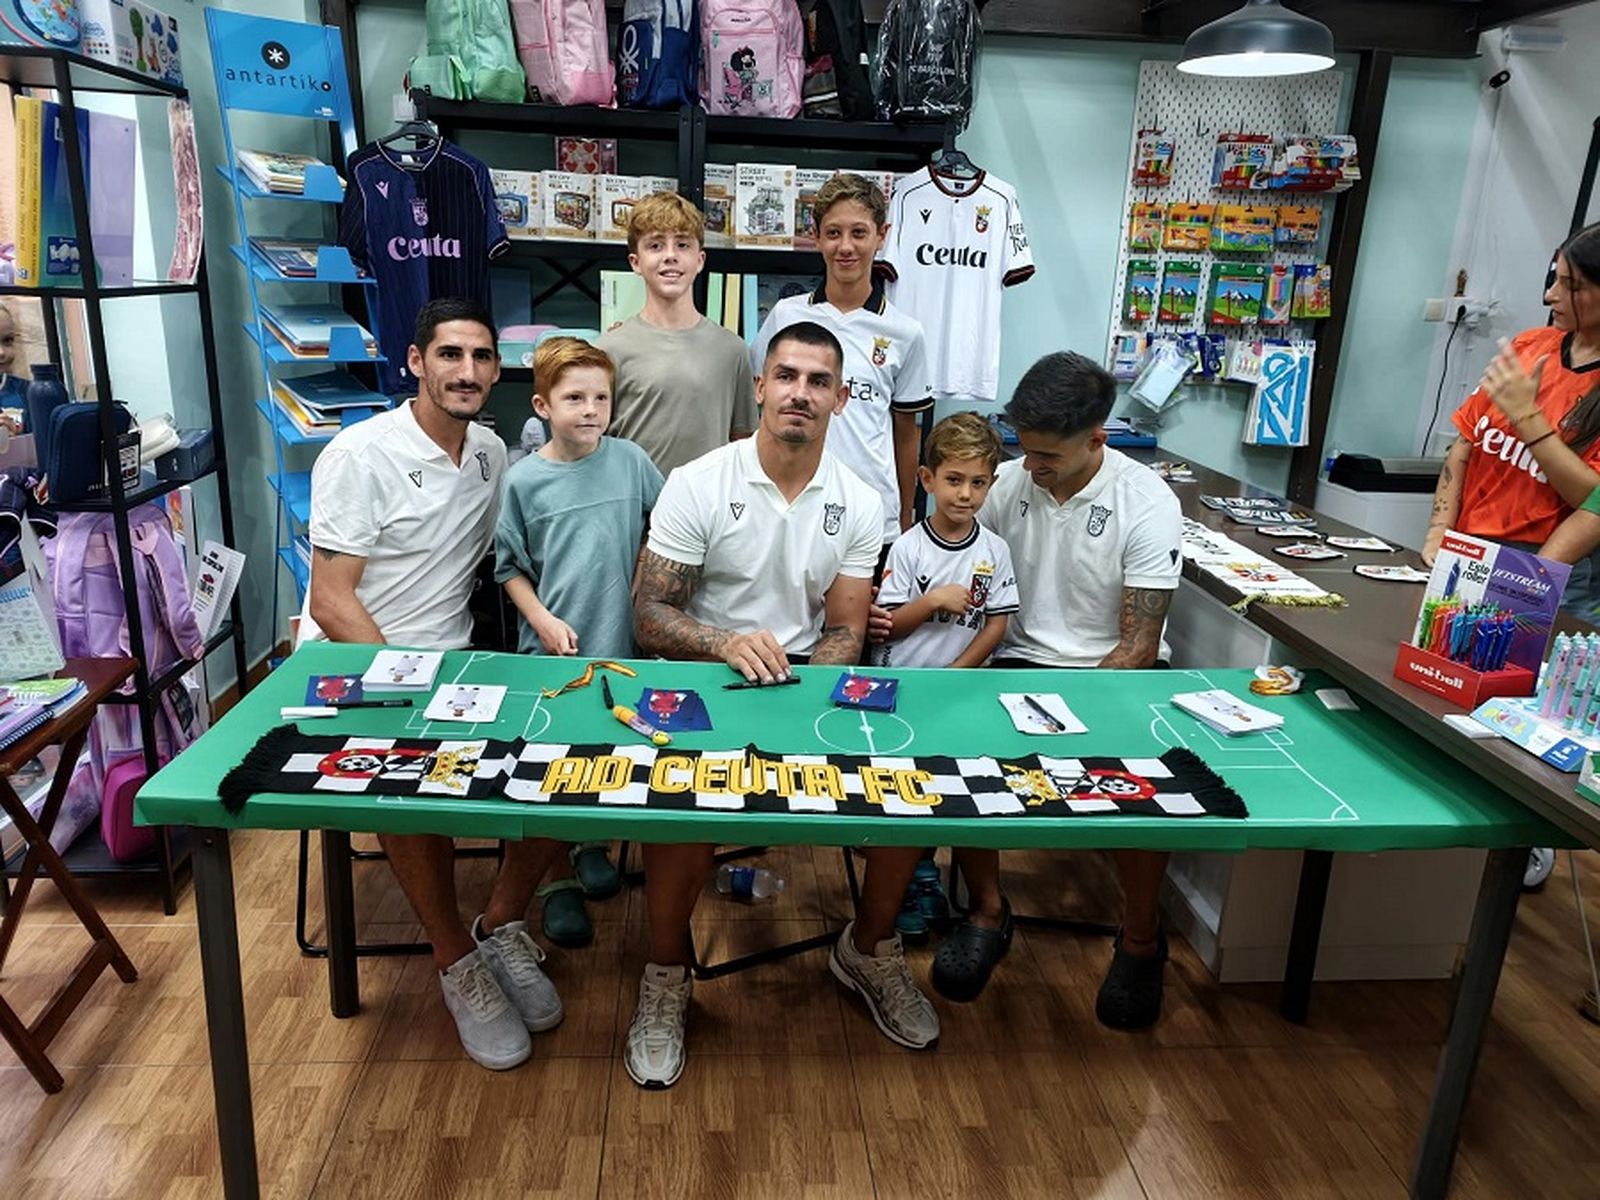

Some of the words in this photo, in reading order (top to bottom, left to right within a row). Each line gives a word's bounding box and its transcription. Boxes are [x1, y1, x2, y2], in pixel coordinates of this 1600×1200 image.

[225, 67, 332, 92] antartiko
[387, 233, 461, 261] Ceuta
[916, 243, 987, 269] Ceuta
[1492, 568, 1553, 593] JETSTREAM
[539, 756, 634, 794] AD
[648, 753, 847, 800] CEUTA
[858, 766, 943, 806] FC
